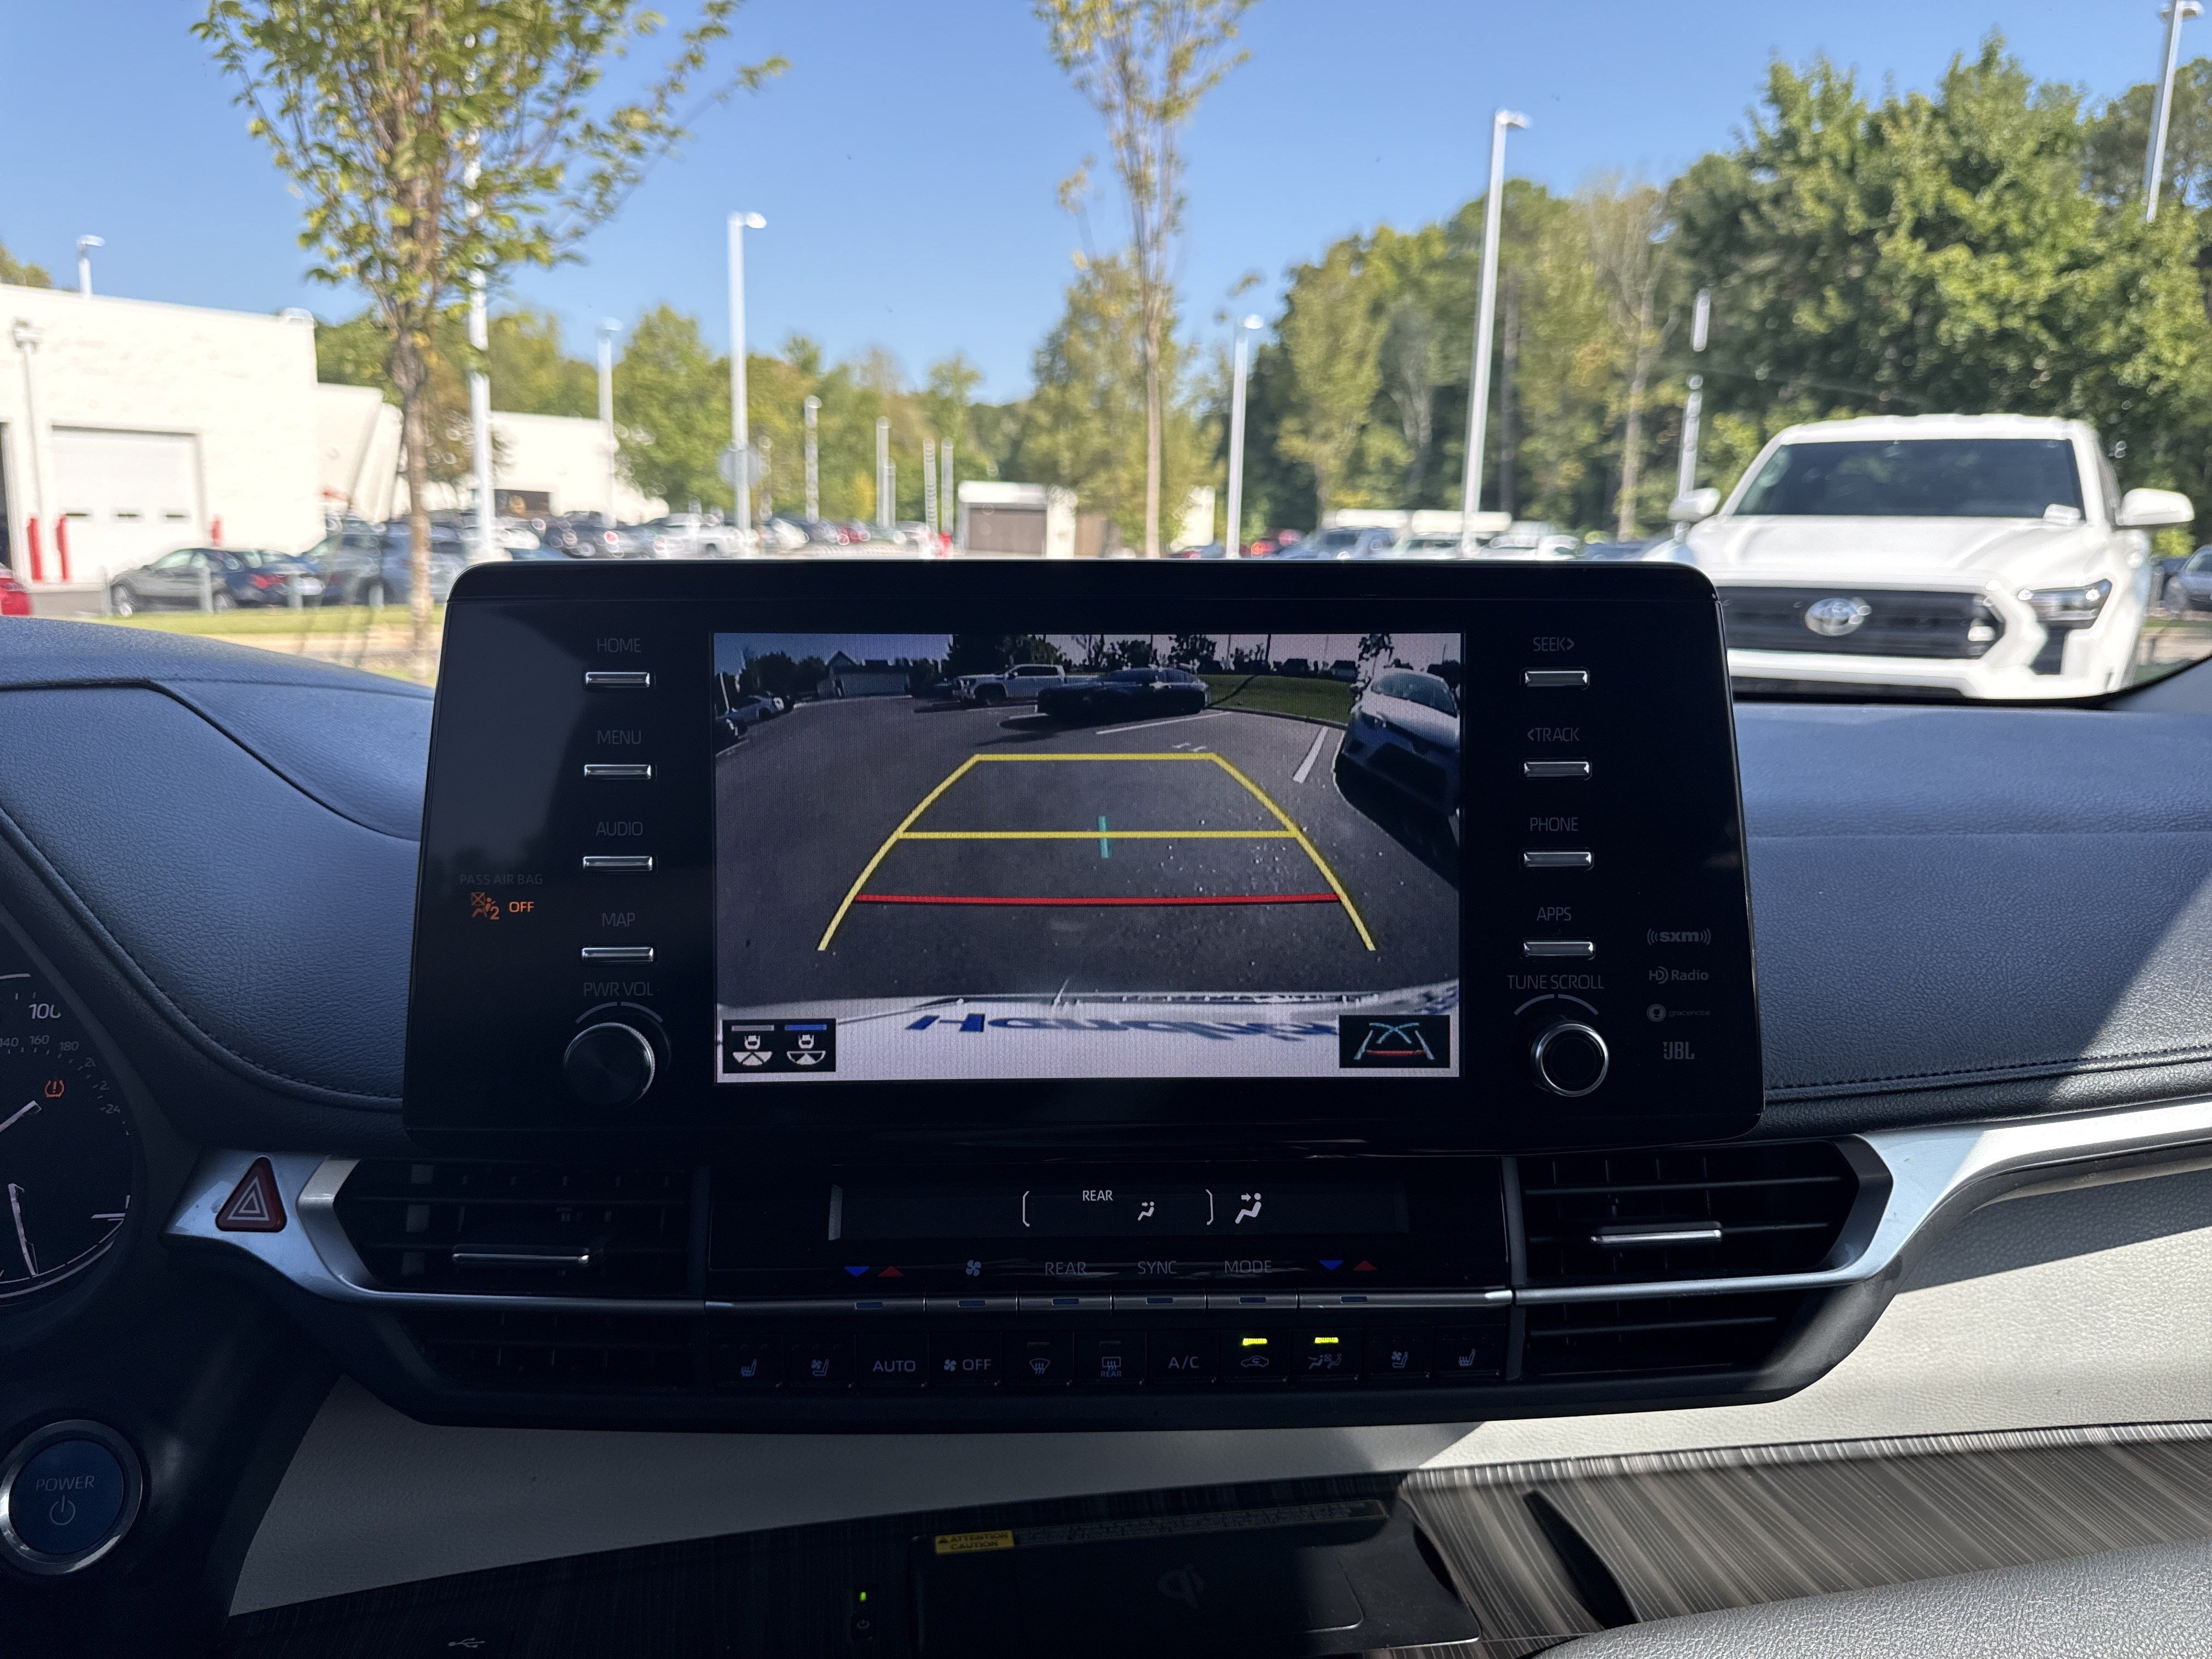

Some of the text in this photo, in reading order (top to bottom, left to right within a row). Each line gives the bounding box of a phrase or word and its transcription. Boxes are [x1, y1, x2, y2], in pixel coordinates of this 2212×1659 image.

[596, 638, 641, 653] HOME
[596, 730, 641, 744] MENU
[596, 822, 644, 836] AUDIO
[1530, 817, 1579, 832] PHONE
[460, 874, 543, 885] PASS AIR BAG
[508, 901, 534, 913] OFF
[1537, 907, 1571, 921] APPS
[602, 913, 636, 927] MAP
[1671, 968, 1709, 981] Radio
[1507, 975, 1605, 989] TUNE SCROLL
[583, 982, 653, 997] PWR VOL
[29, 1035, 50, 1045] 160
[59, 1041, 79, 1051] 180
[1663, 1041, 1695, 1060] JBL
[1082, 1189, 1113, 1201] REAR
[1045, 1260, 1272, 1275] REAR SYNC MODE
[873, 1356, 1199, 1373] AUTO OFF A/C
[1099, 1370, 1123, 1378] REAR
[36, 1475, 95, 1492] POWER
[950, 1532, 1009, 1542] ATTENTION
[950, 1541, 999, 1550] CAUTION
